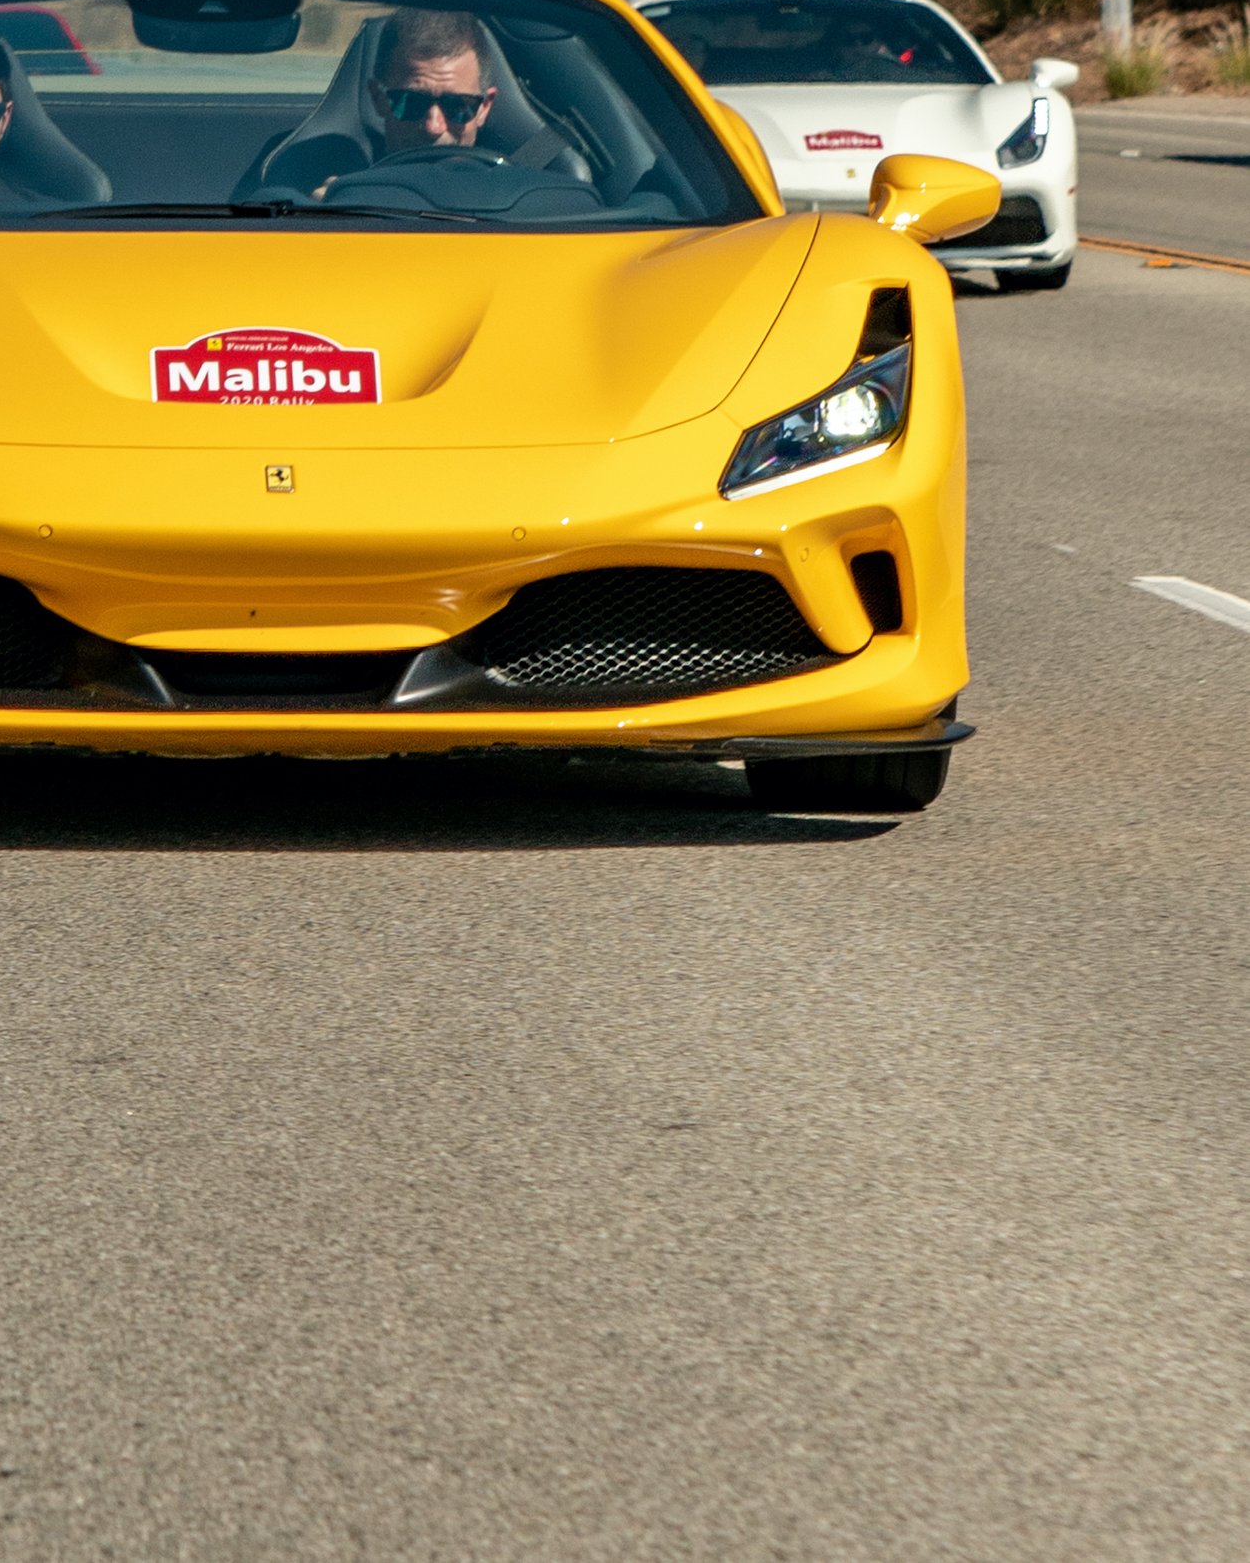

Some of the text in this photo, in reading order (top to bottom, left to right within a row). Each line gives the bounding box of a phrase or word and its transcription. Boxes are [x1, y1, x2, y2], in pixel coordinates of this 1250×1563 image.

[226, 342, 334, 354] Ferrari Los Angeles
[168, 359, 362, 393] Malibu
[220, 395, 263, 406] 2020
